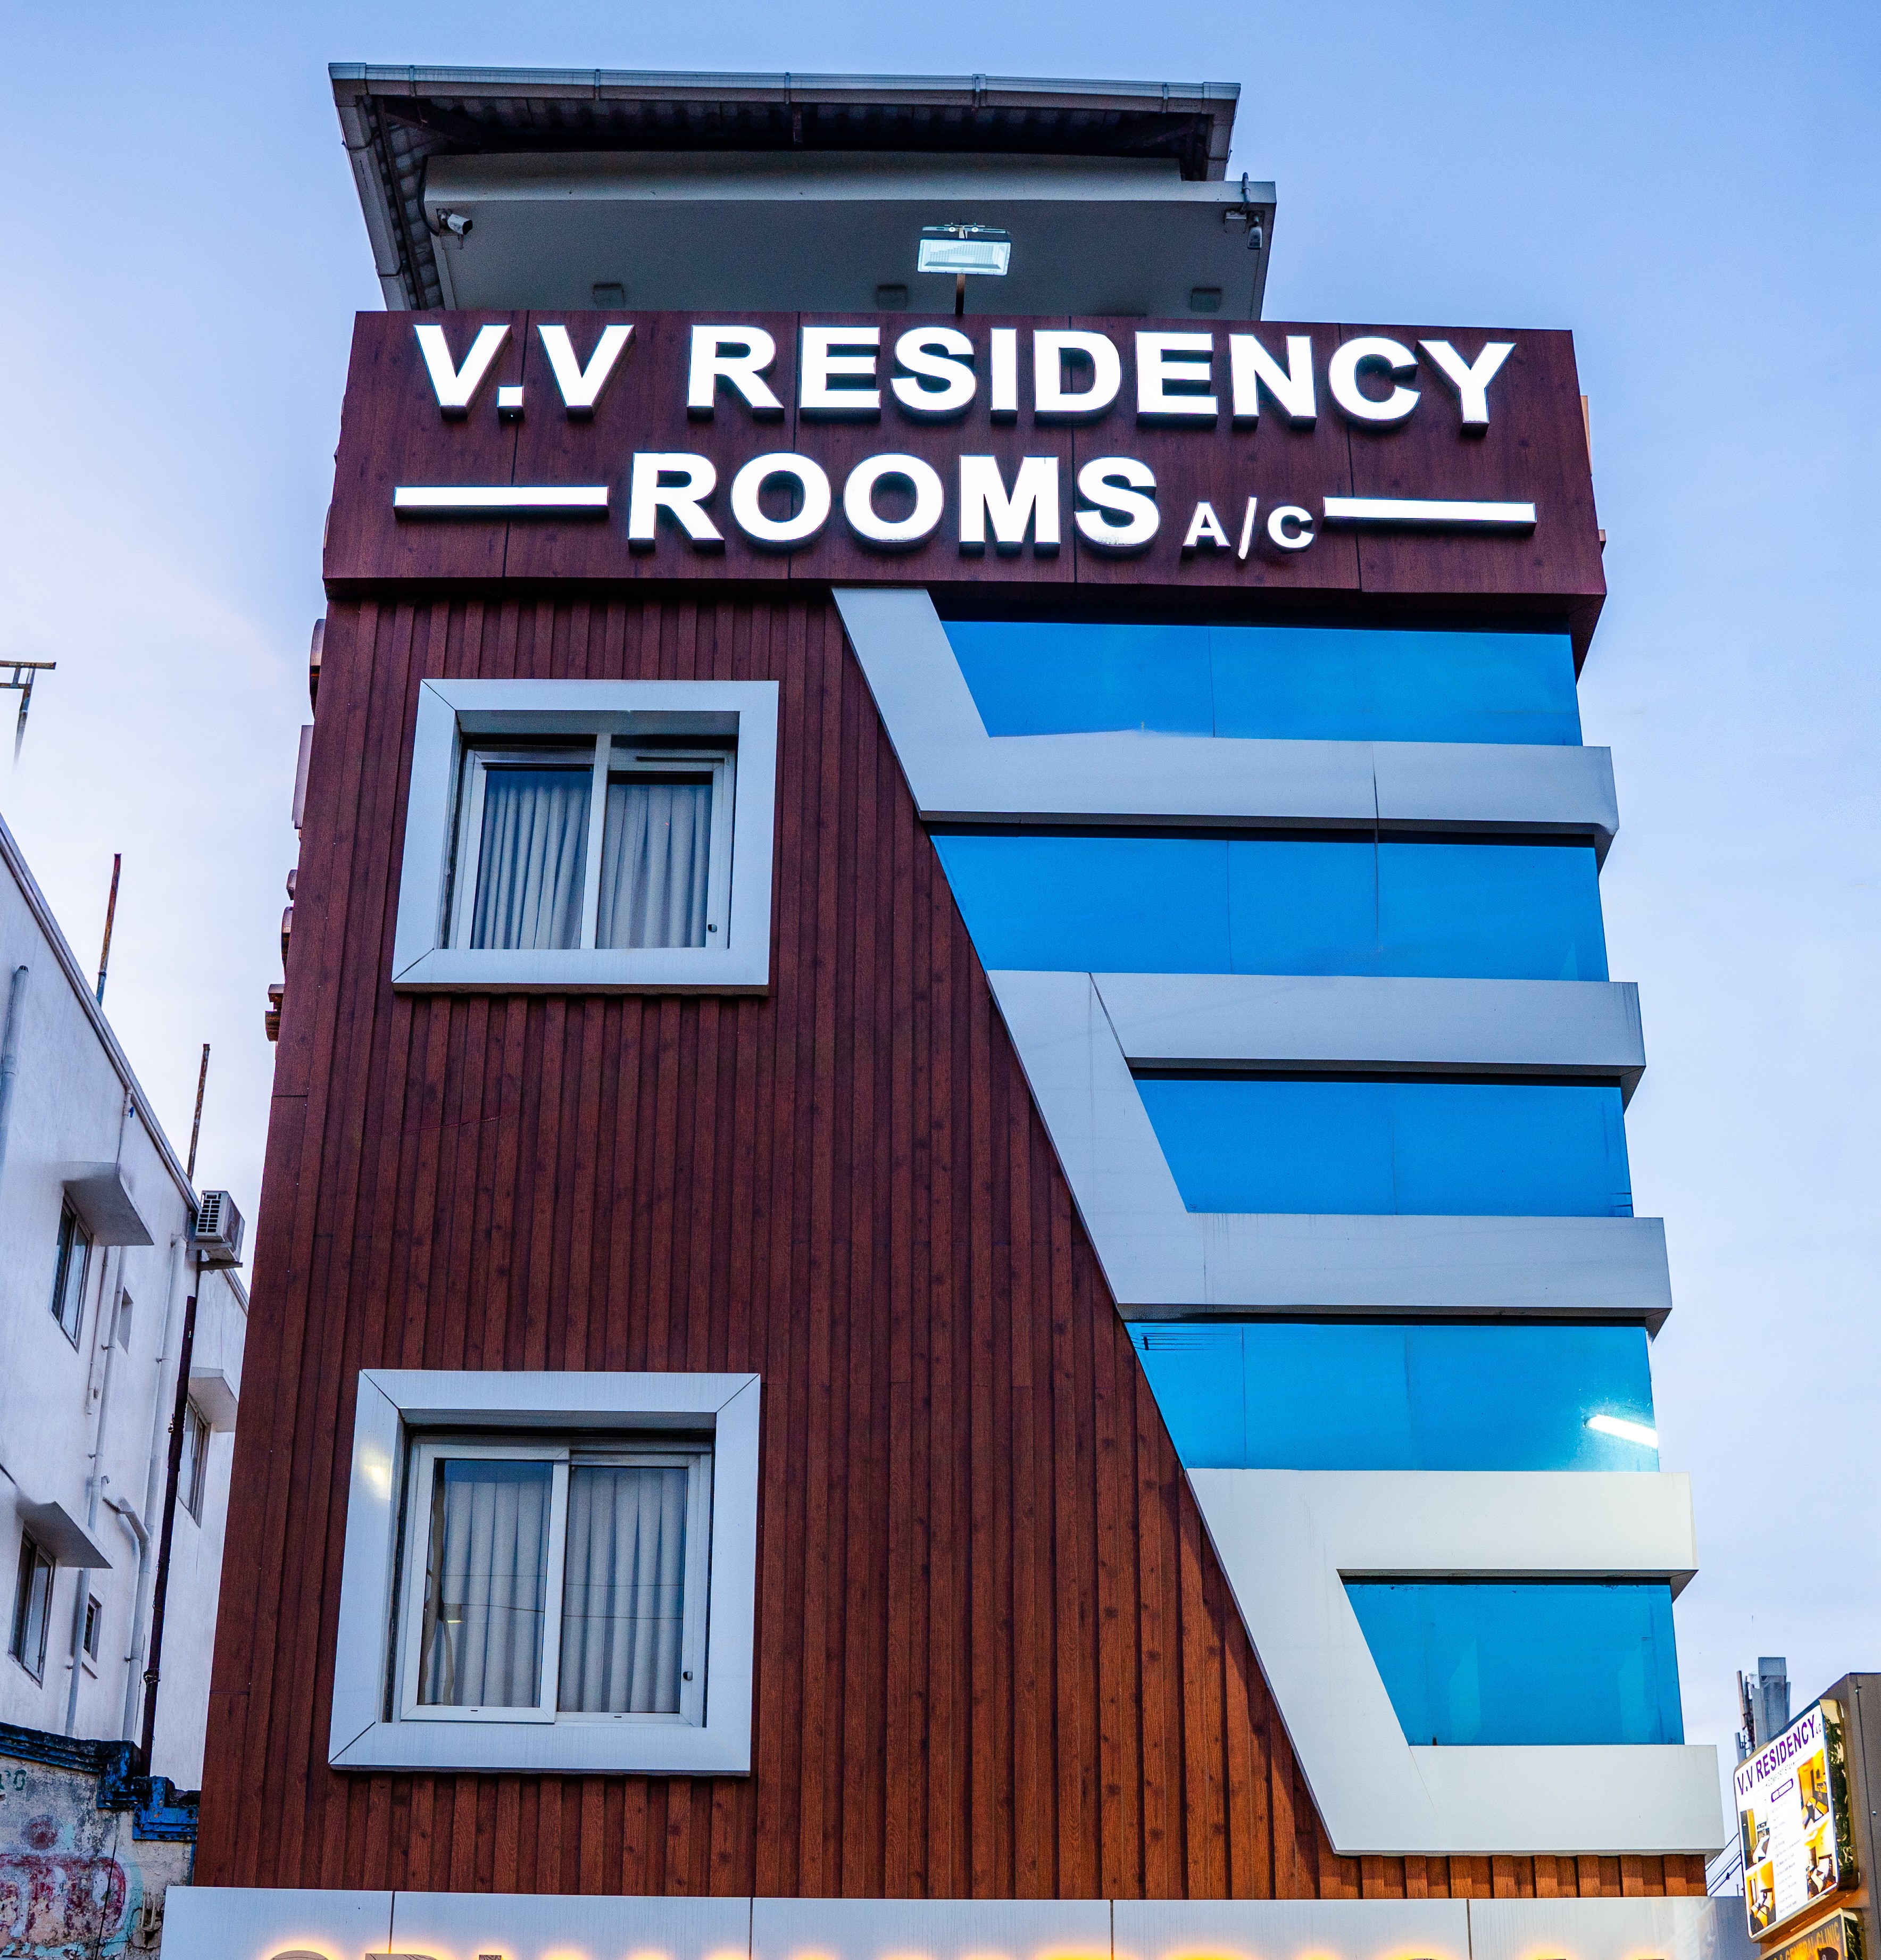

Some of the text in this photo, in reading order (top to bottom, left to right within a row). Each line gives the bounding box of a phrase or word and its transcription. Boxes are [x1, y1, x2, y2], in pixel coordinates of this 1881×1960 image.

[413, 324, 1517, 429] V.V RESIDENCY
[628, 452, 1315, 560] ROOMS A/C
[1737, 1765, 1753, 1796] V.V
[1755, 1714, 1815, 1782] RESIDENCY
